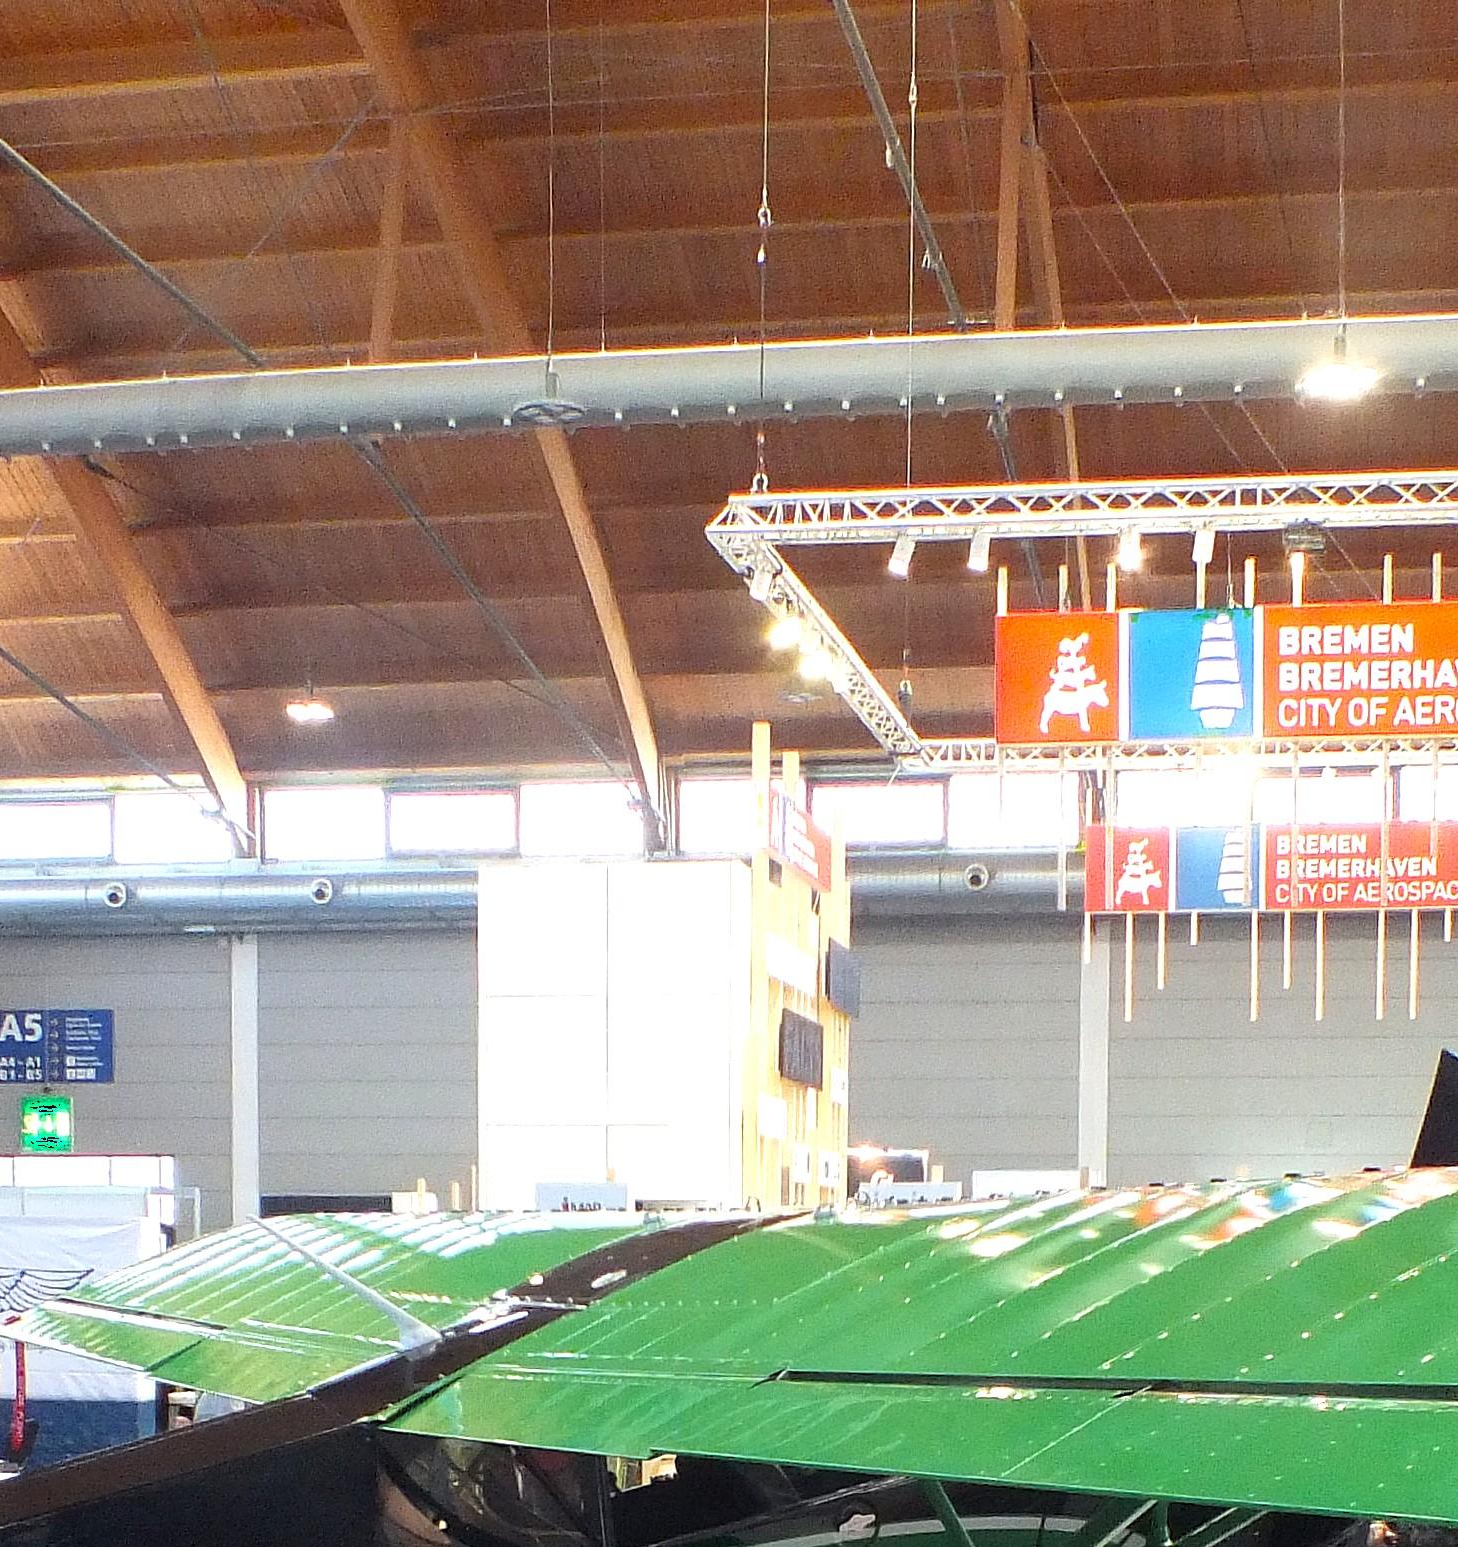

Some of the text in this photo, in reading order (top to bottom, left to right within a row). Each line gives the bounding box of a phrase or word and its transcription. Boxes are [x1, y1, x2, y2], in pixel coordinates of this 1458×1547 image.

[1278, 623, 1414, 656] BREMEN
[1278, 697, 1342, 728] CITY
[1348, 696, 1390, 726] OF
[1276, 834, 1367, 855] BREMEN
[1275, 882, 1319, 903] CTY
[1322, 882, 1350, 902] OF
